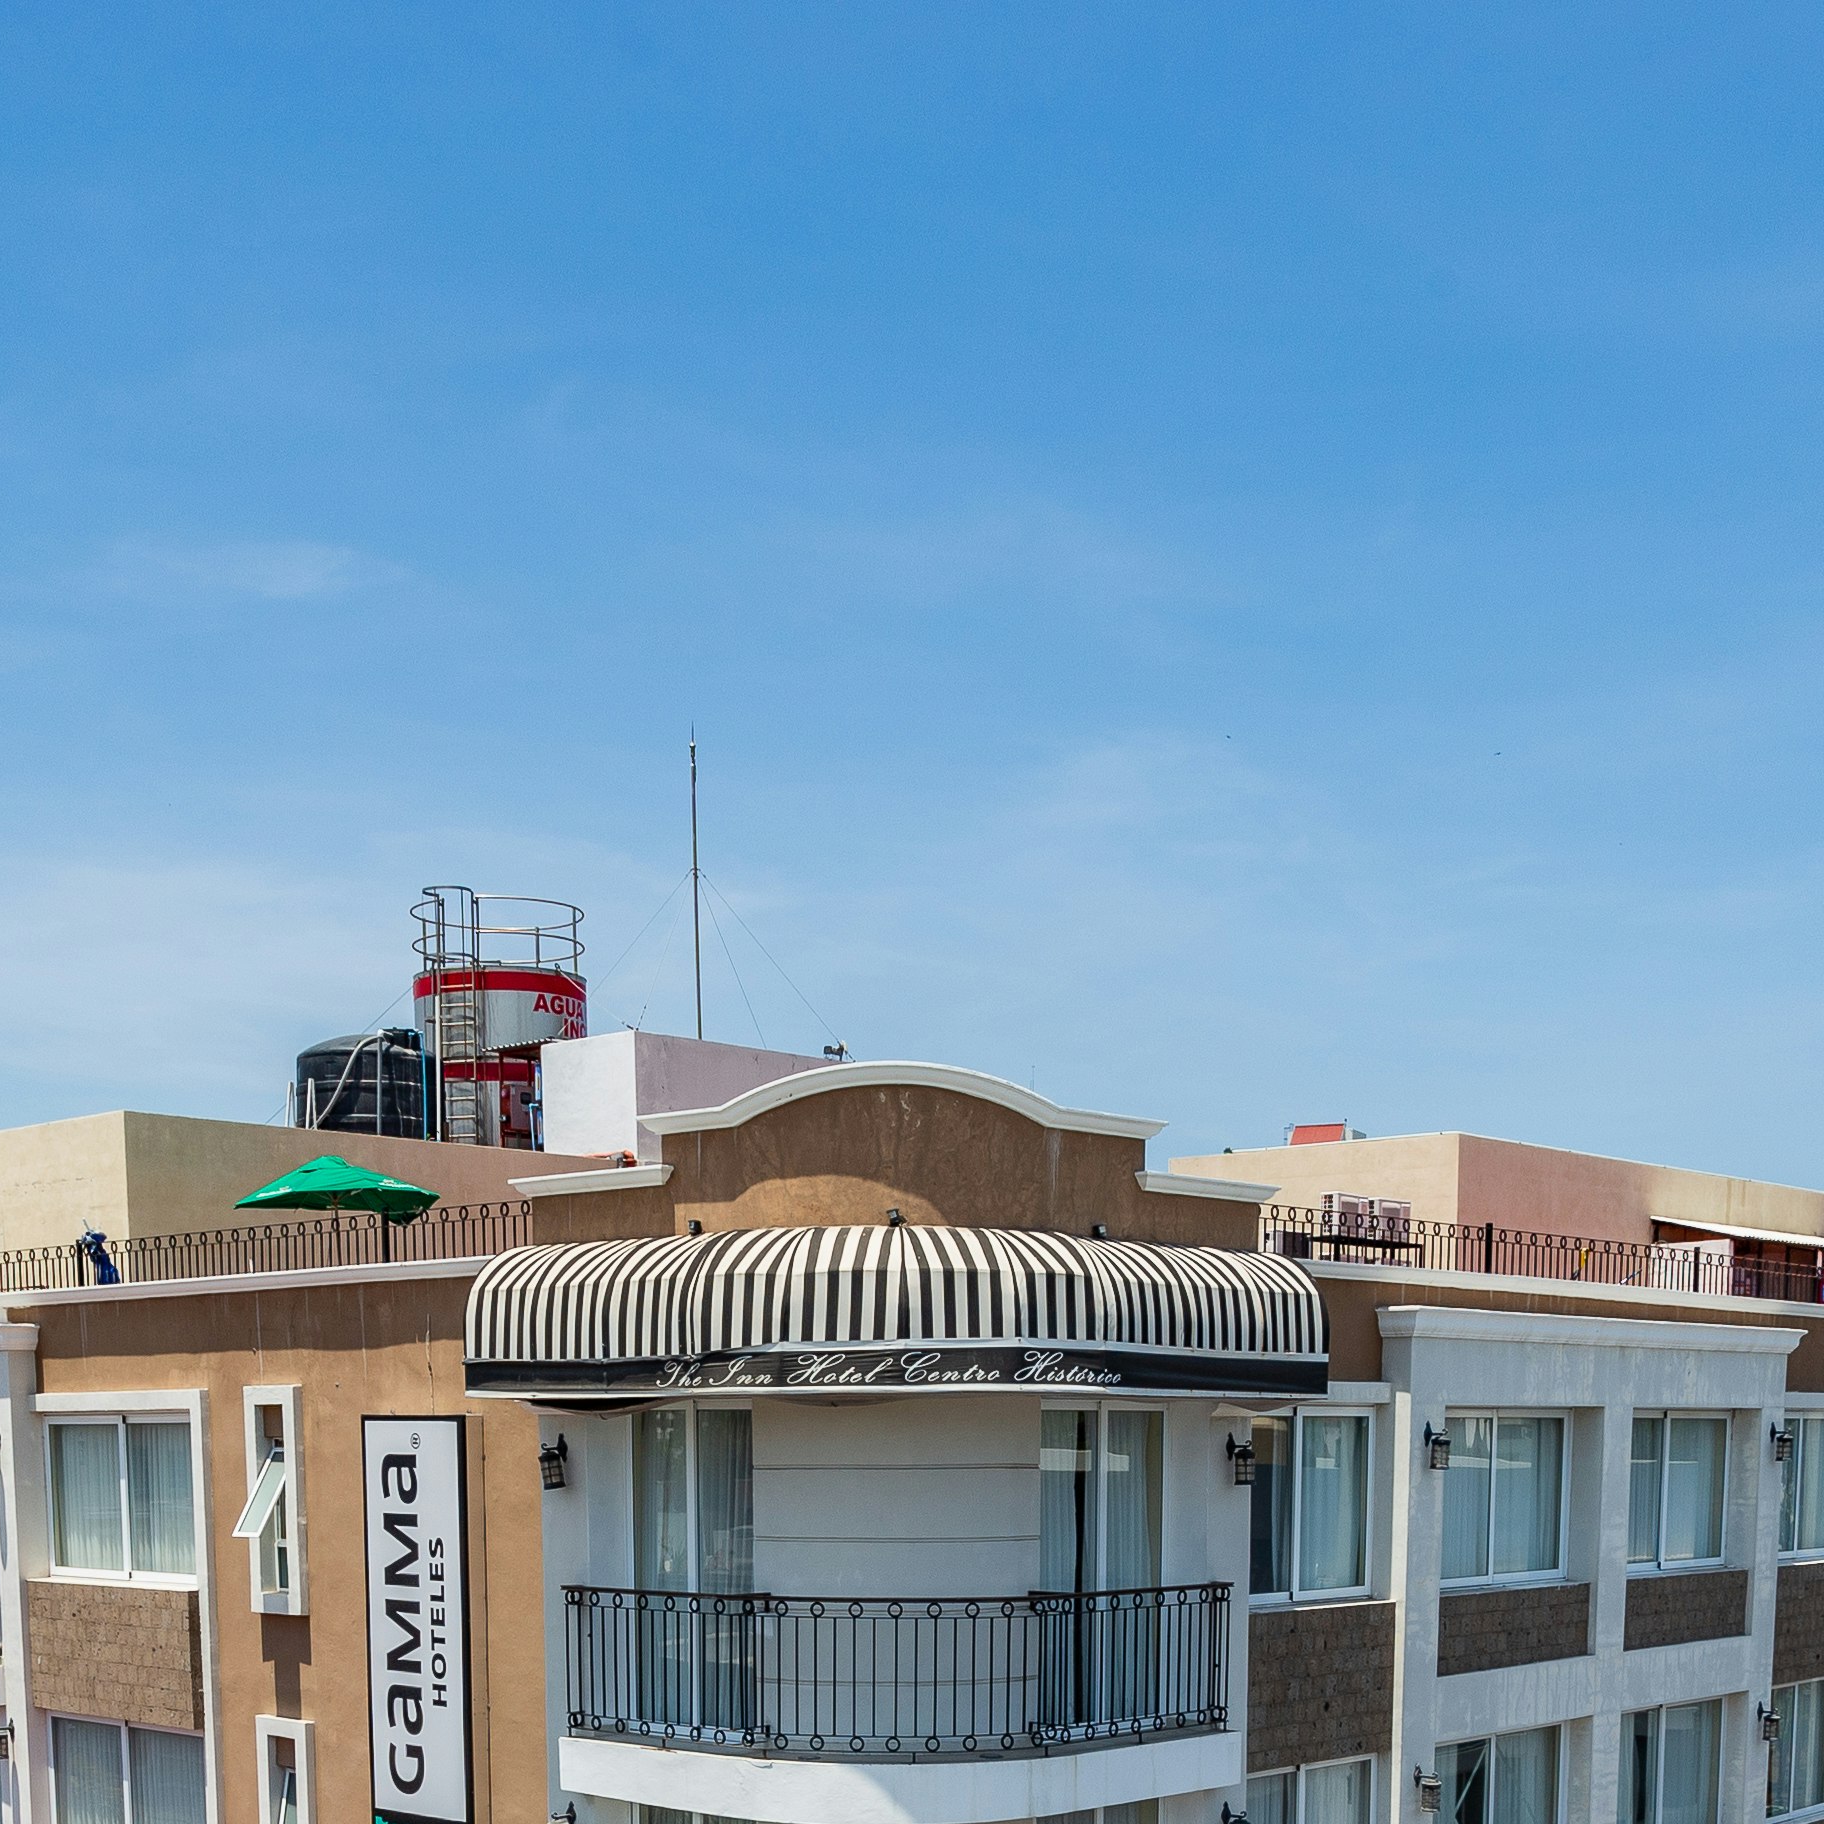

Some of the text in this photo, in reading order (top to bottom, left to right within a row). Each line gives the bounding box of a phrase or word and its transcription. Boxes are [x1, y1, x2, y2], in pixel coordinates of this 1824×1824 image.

[533, 993, 584, 1021] AGUA
[656, 1350, 1122, 1388] The Inn Hotel Centro Histórico
[428, 1536, 448, 1709] HOTELES
